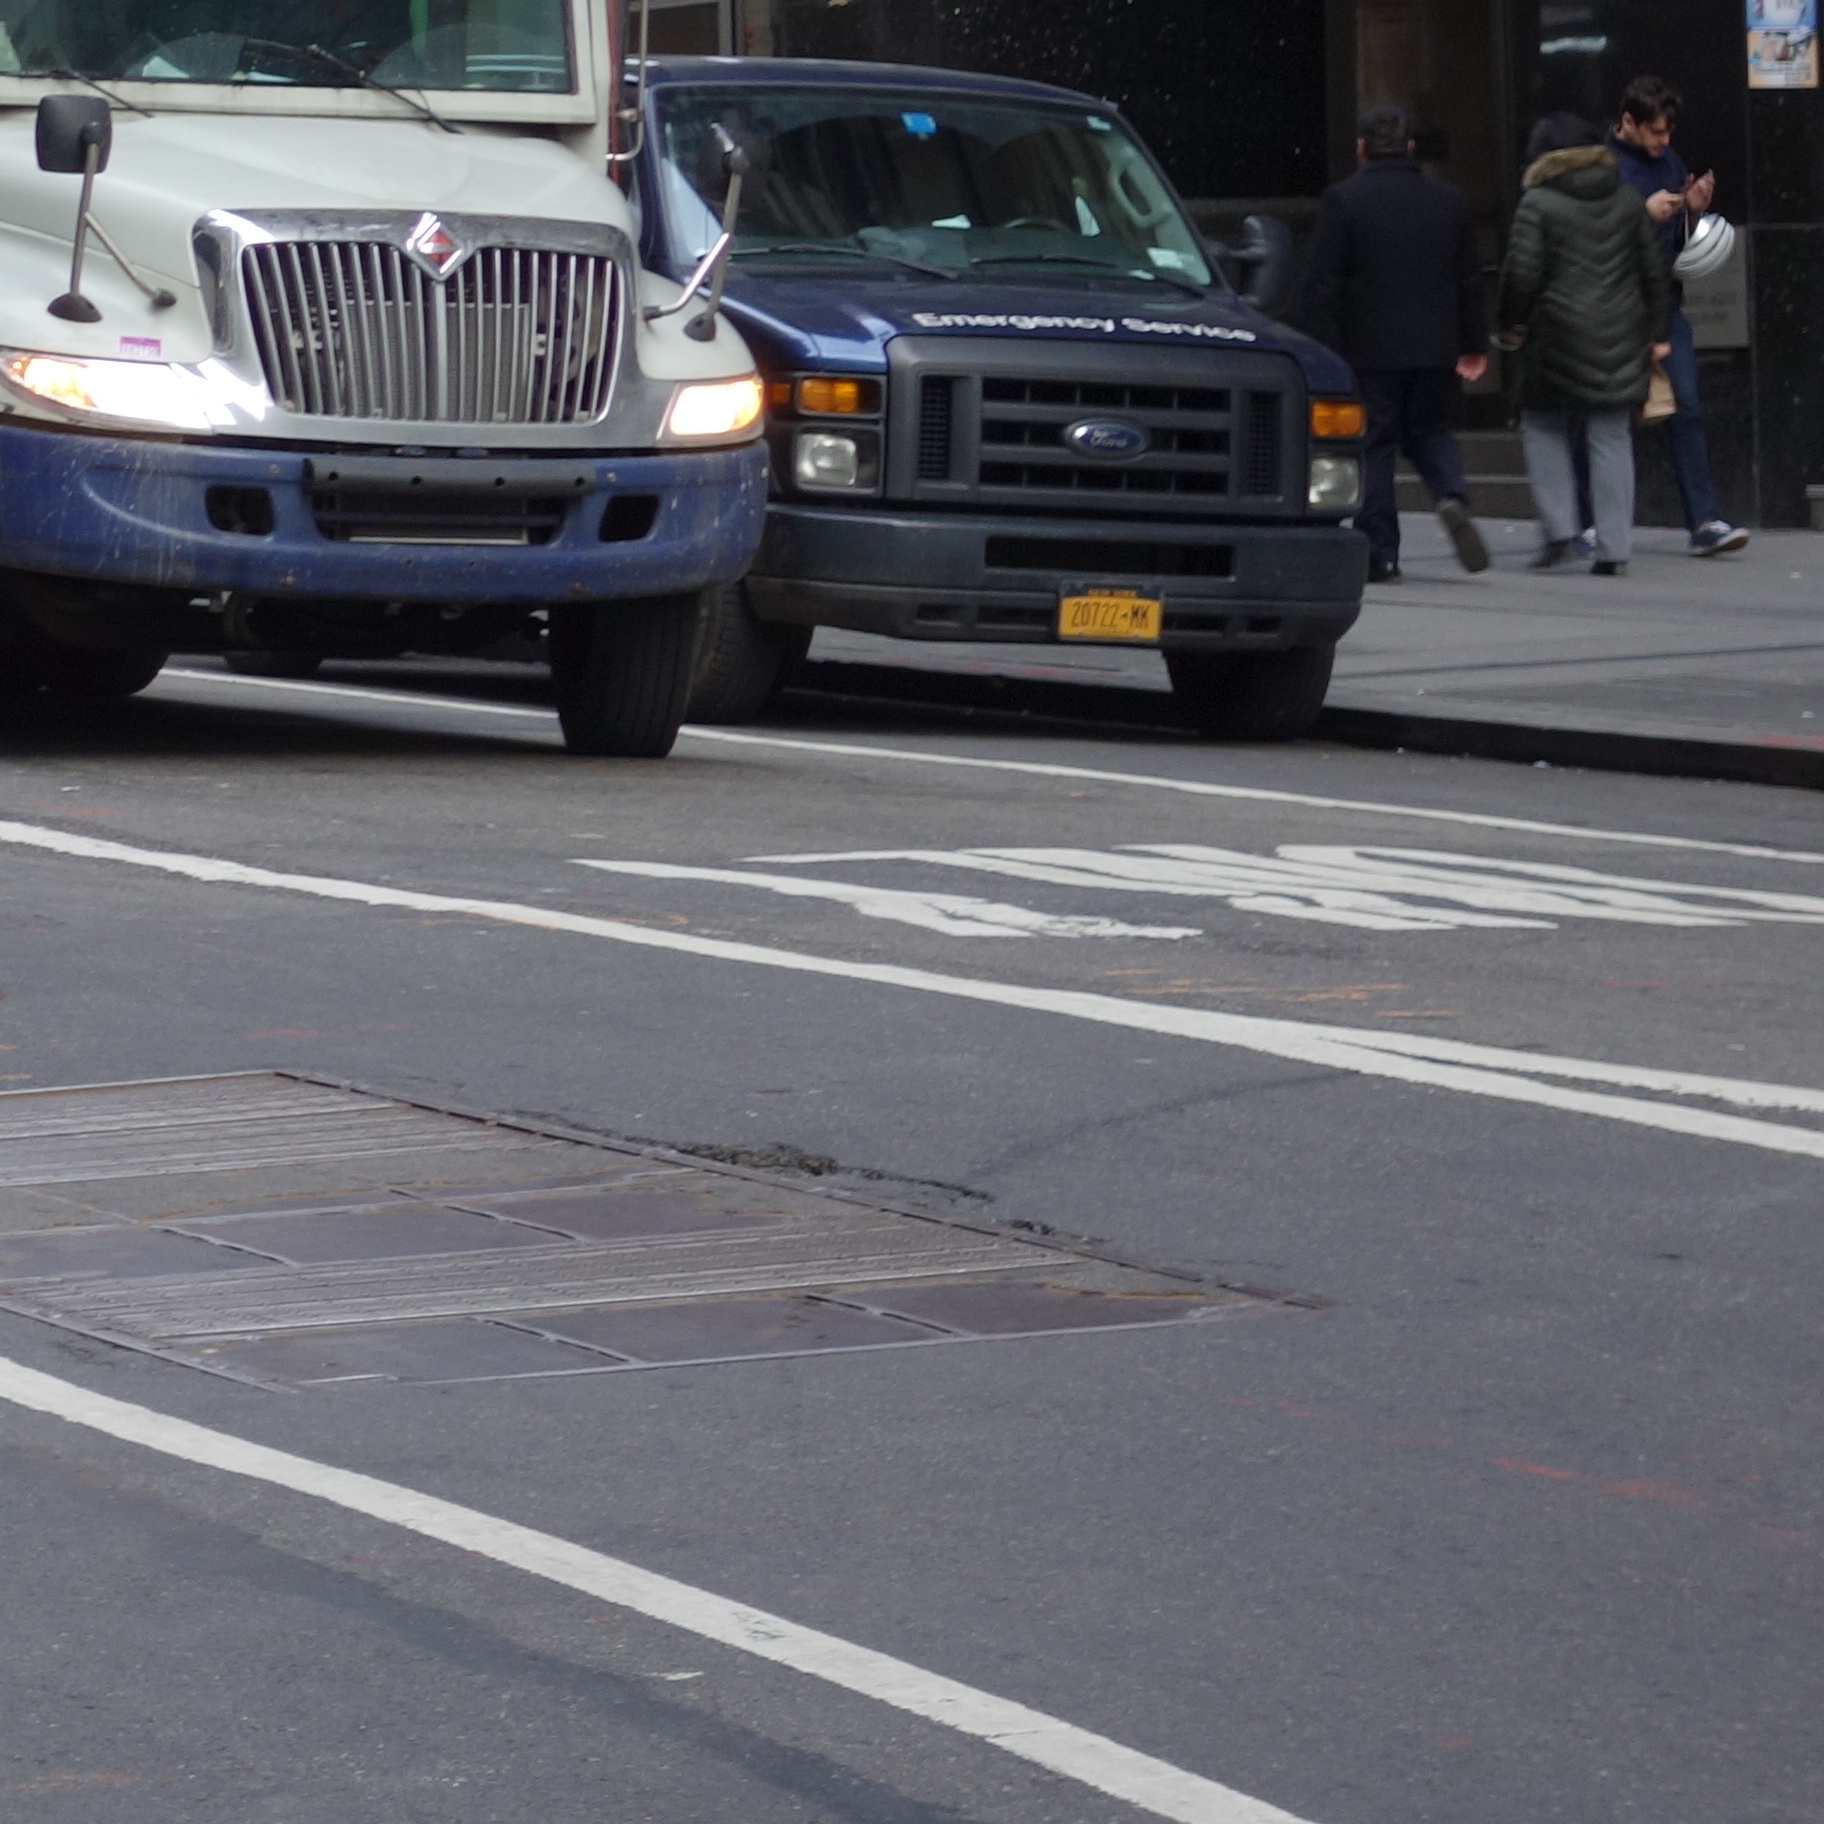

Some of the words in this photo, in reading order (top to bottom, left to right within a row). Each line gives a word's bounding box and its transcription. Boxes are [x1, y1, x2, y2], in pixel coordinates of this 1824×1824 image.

[911, 312, 1115, 332] Emergency
[1121, 317, 1256, 342] Service
[1071, 600, 1119, 628] 20722
